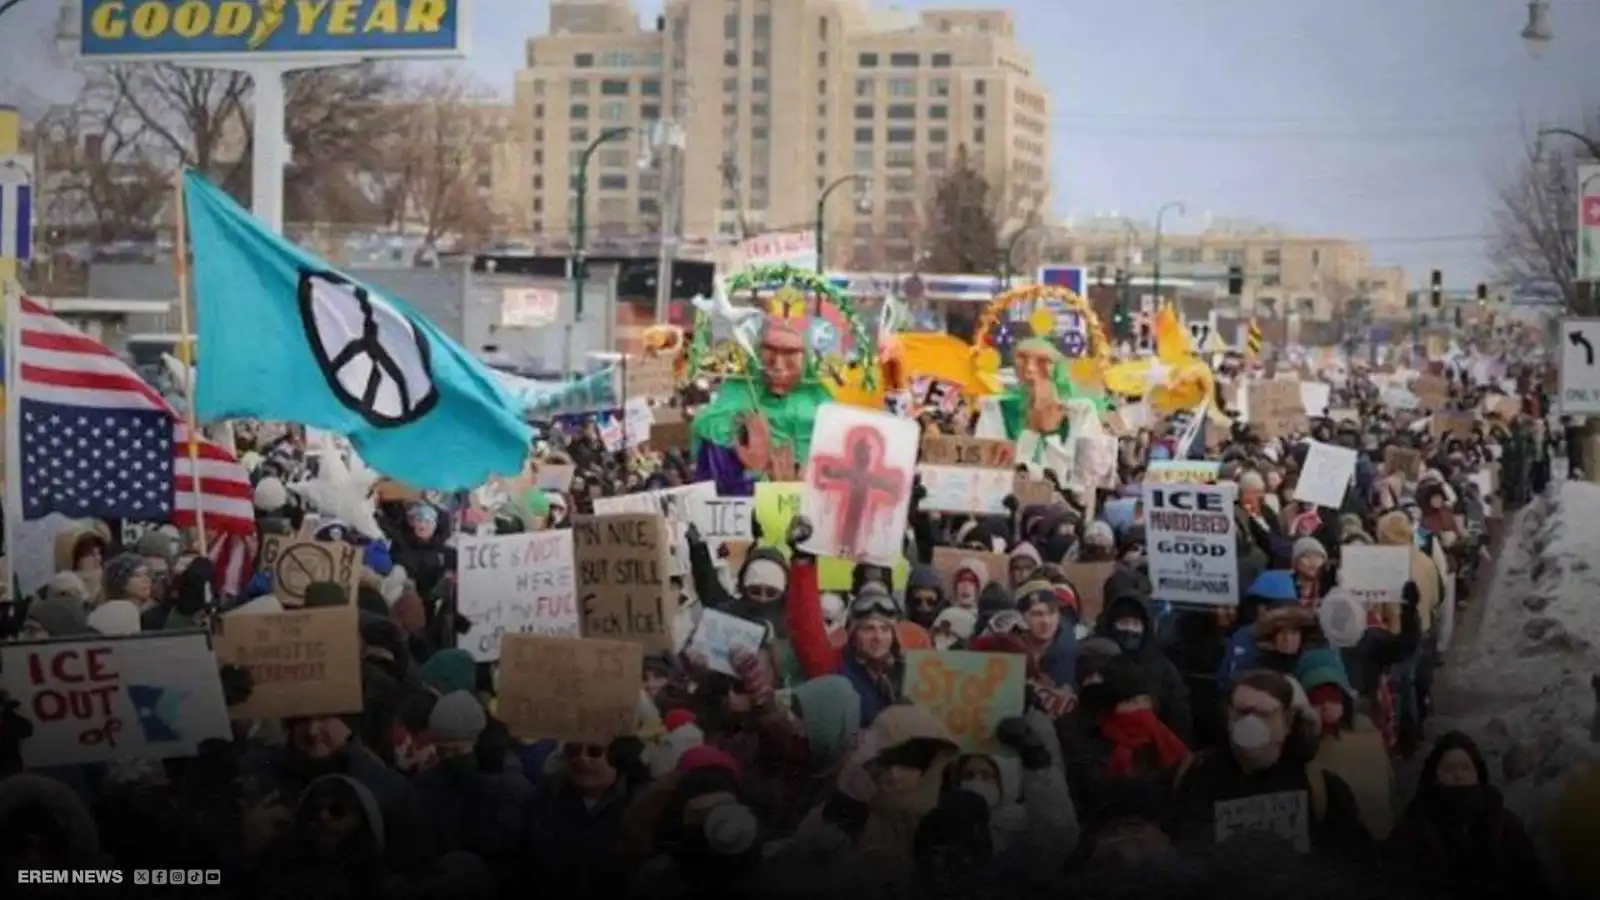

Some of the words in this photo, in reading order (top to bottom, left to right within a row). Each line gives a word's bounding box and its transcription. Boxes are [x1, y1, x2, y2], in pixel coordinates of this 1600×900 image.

[1152, 489, 1224, 513] ICE
[704, 500, 747, 537] ICE
[1150, 510, 1230, 535] MURDERED
[465, 543, 501, 570] ICE
[523, 536, 562, 566] NOT
[1157, 540, 1227, 557] GOOD
[516, 565, 572, 592] HERE
[613, 557, 663, 587] STILL
[28, 647, 120, 685] ICE
[913, 655, 1012, 706] STOP
[32, 685, 120, 724] OUT
[78, 716, 124, 749] of
